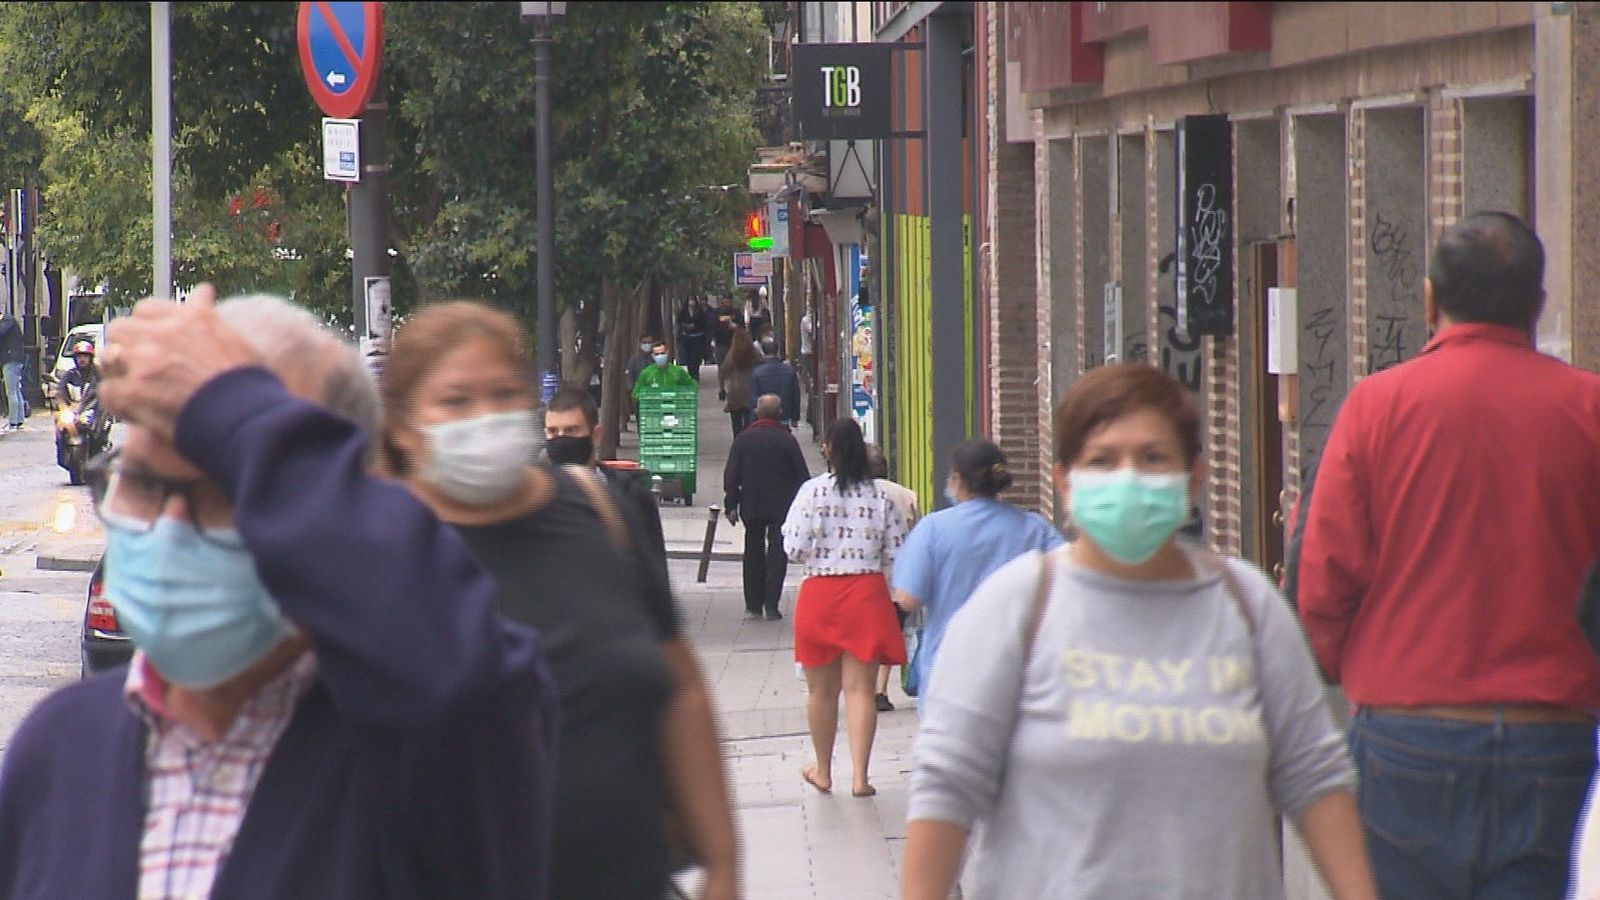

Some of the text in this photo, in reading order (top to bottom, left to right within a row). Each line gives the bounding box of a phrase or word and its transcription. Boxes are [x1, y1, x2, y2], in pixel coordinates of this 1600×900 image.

[821, 66, 861, 106] TGB
[1062, 650, 1193, 693] STAY
[1069, 701, 1266, 744] MOTION
